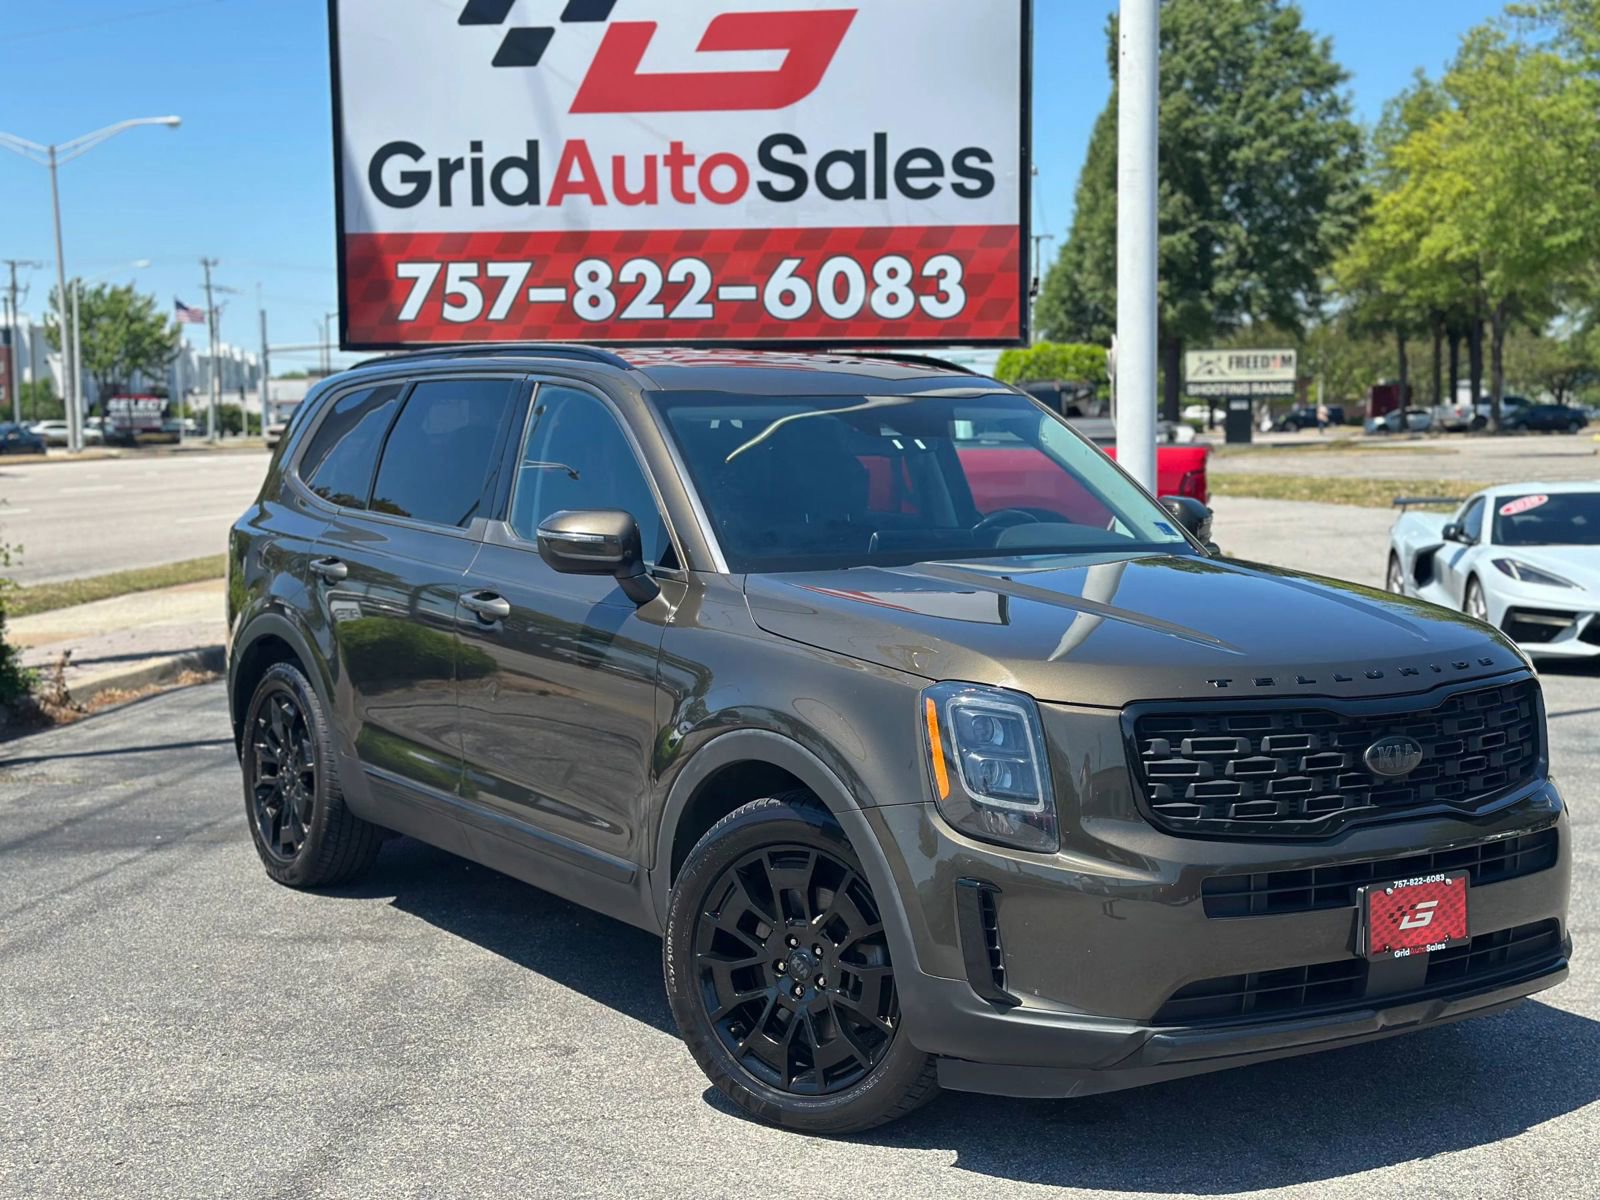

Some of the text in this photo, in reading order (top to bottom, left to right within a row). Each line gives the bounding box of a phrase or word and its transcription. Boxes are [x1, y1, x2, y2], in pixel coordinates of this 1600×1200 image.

[367, 132, 995, 208] GridAutoSales
[396, 254, 966, 323] 757-822-6083
[1206, 656, 1494, 688] TELLURIDE
[1377, 743, 1416, 769] KIA
[1393, 873, 1445, 889] 757-822-6083
